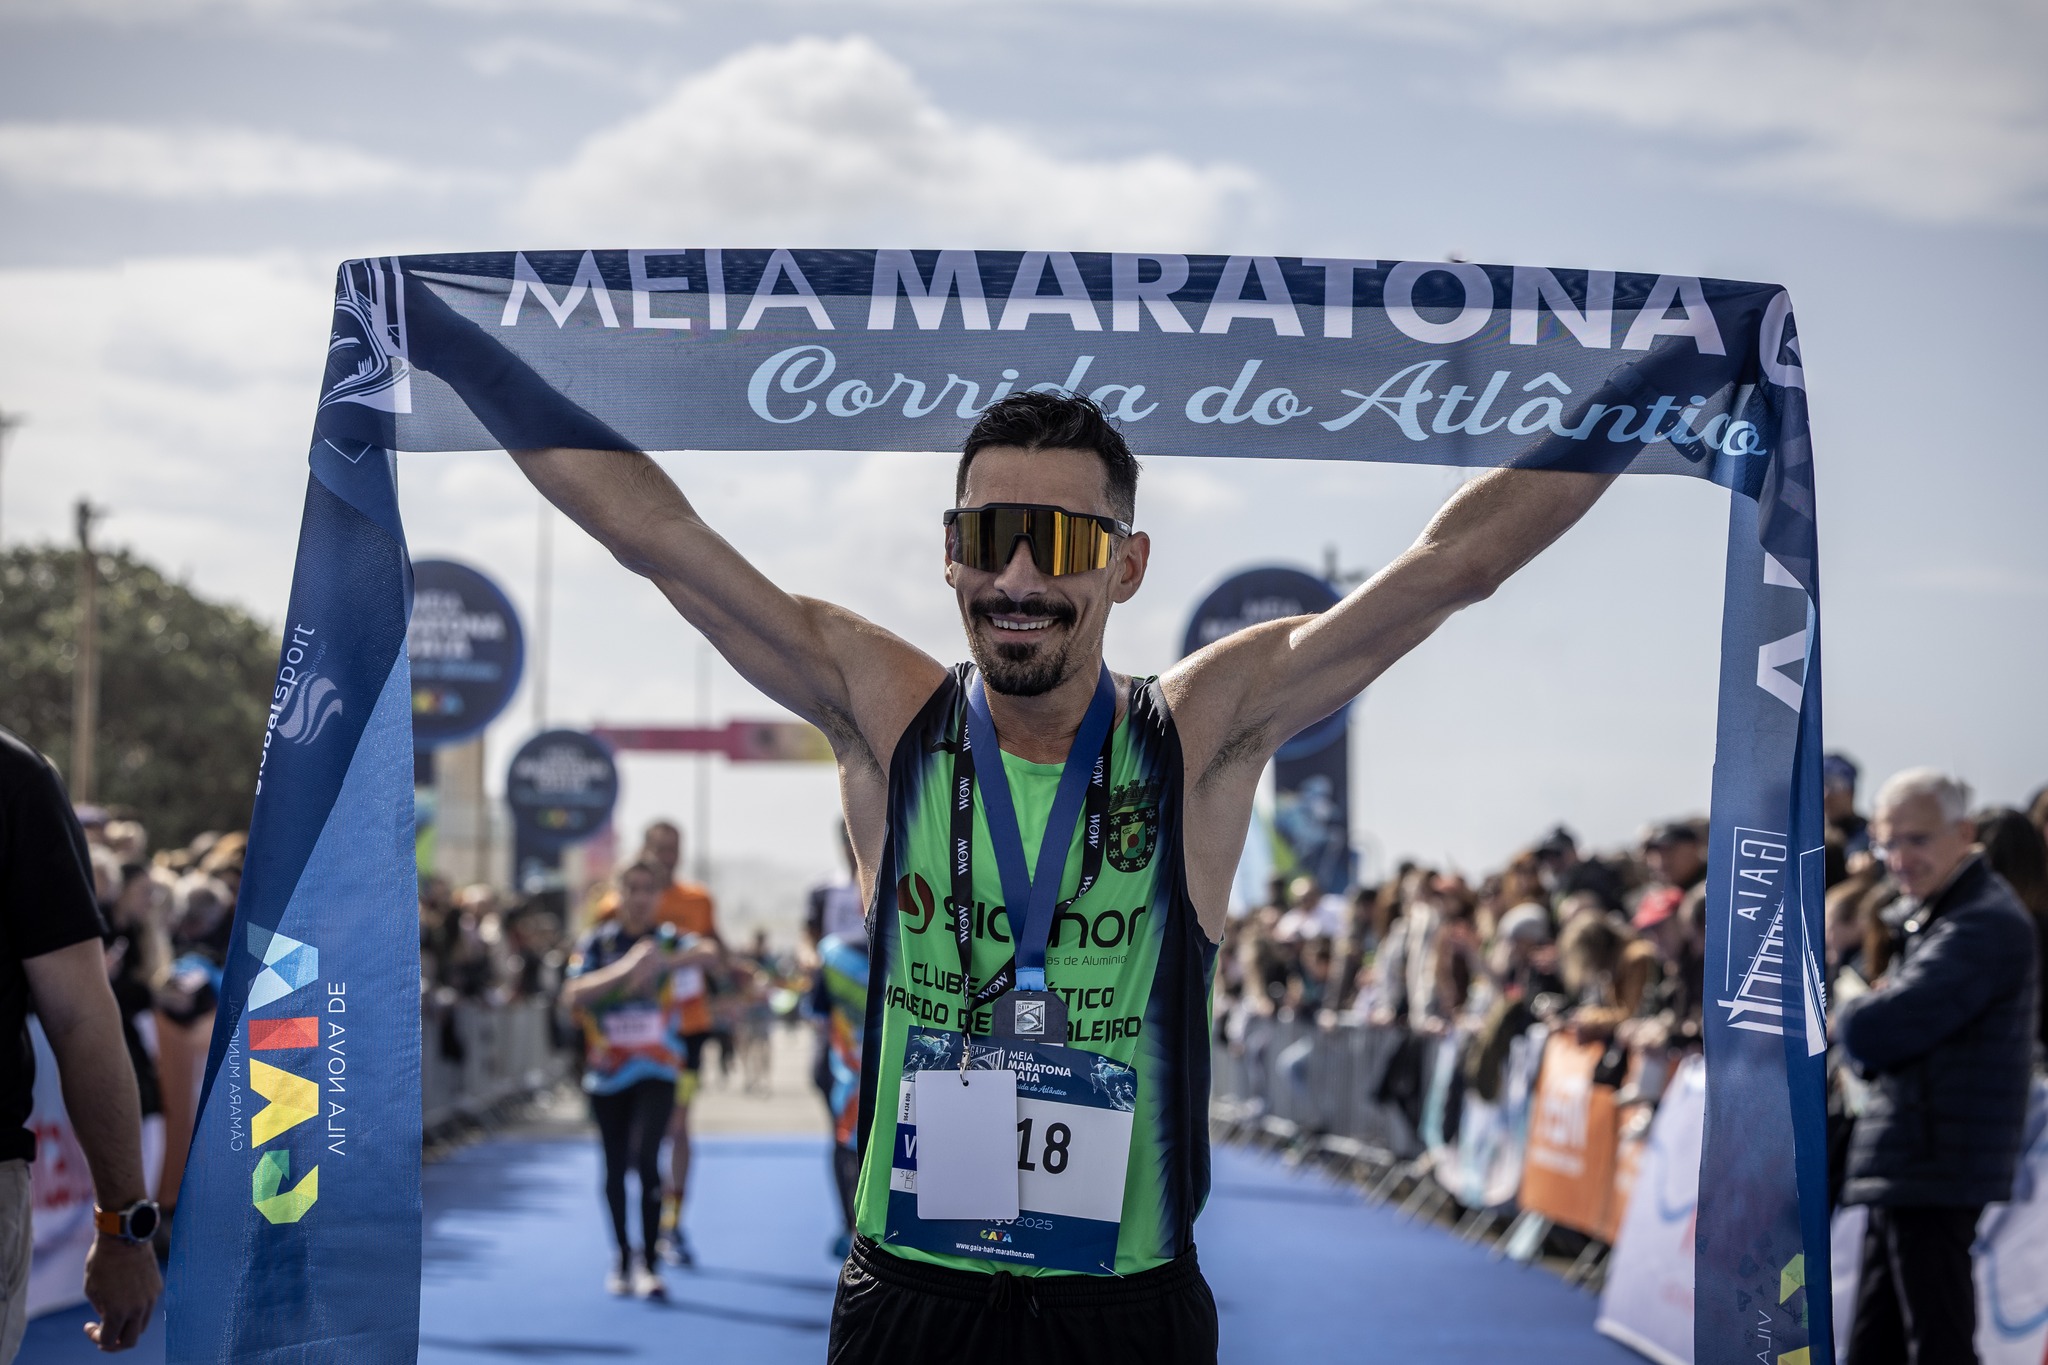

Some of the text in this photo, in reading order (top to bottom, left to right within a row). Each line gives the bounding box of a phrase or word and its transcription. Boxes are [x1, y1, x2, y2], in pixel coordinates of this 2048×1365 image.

[500, 248, 834, 330] MEIA
[866, 248, 1726, 356] MARATONA
[747, 345, 1767, 456] Corrida do Atlântico
[959, 776, 970, 811] WOW
[1088, 813, 1101, 849] WOW
[957, 838, 969, 875] WOW
[958, 905, 970, 943] WOW
[1063, 956, 1078, 966] de
[1081, 955, 1128, 966] Alumínio
[911, 962, 980, 998] CLUBE
[977, 972, 1009, 1000] WOW
[1007, 1060, 1072, 1077] MARATONA
[1008, 1050, 1034, 1062] MEIA
[1016, 1071, 1040, 1083] AIA
[1016, 1216, 1053, 1231] 2025
[955, 1242, 1035, 1260] www.gaia-half-marathon.com
